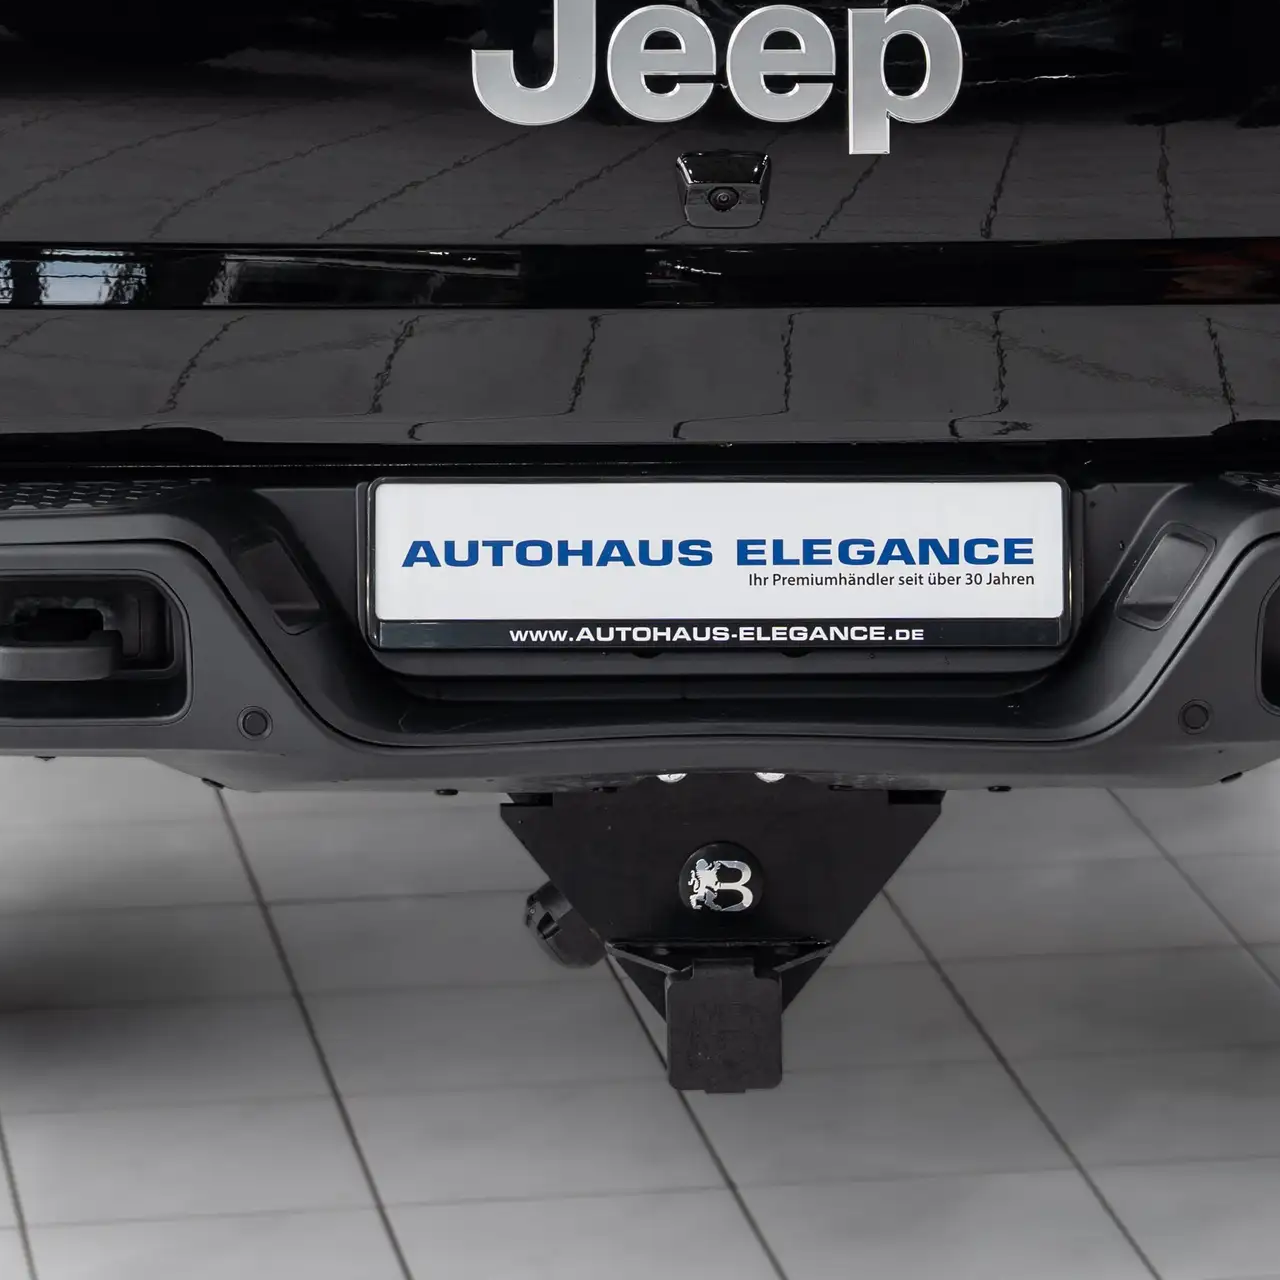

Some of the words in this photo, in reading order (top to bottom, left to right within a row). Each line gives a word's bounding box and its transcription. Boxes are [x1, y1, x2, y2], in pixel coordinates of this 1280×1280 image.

[401, 539, 714, 568] AUTOHAUS
[736, 537, 1035, 566] ELEGANCE
[749, 572, 769, 587] Ihr
[772, 571, 895, 587] Premiumhändler
[898, 572, 924, 587] seit
[927, 571, 962, 587] über
[965, 572, 983, 587] 30
[986, 571, 1035, 587] Jahren
